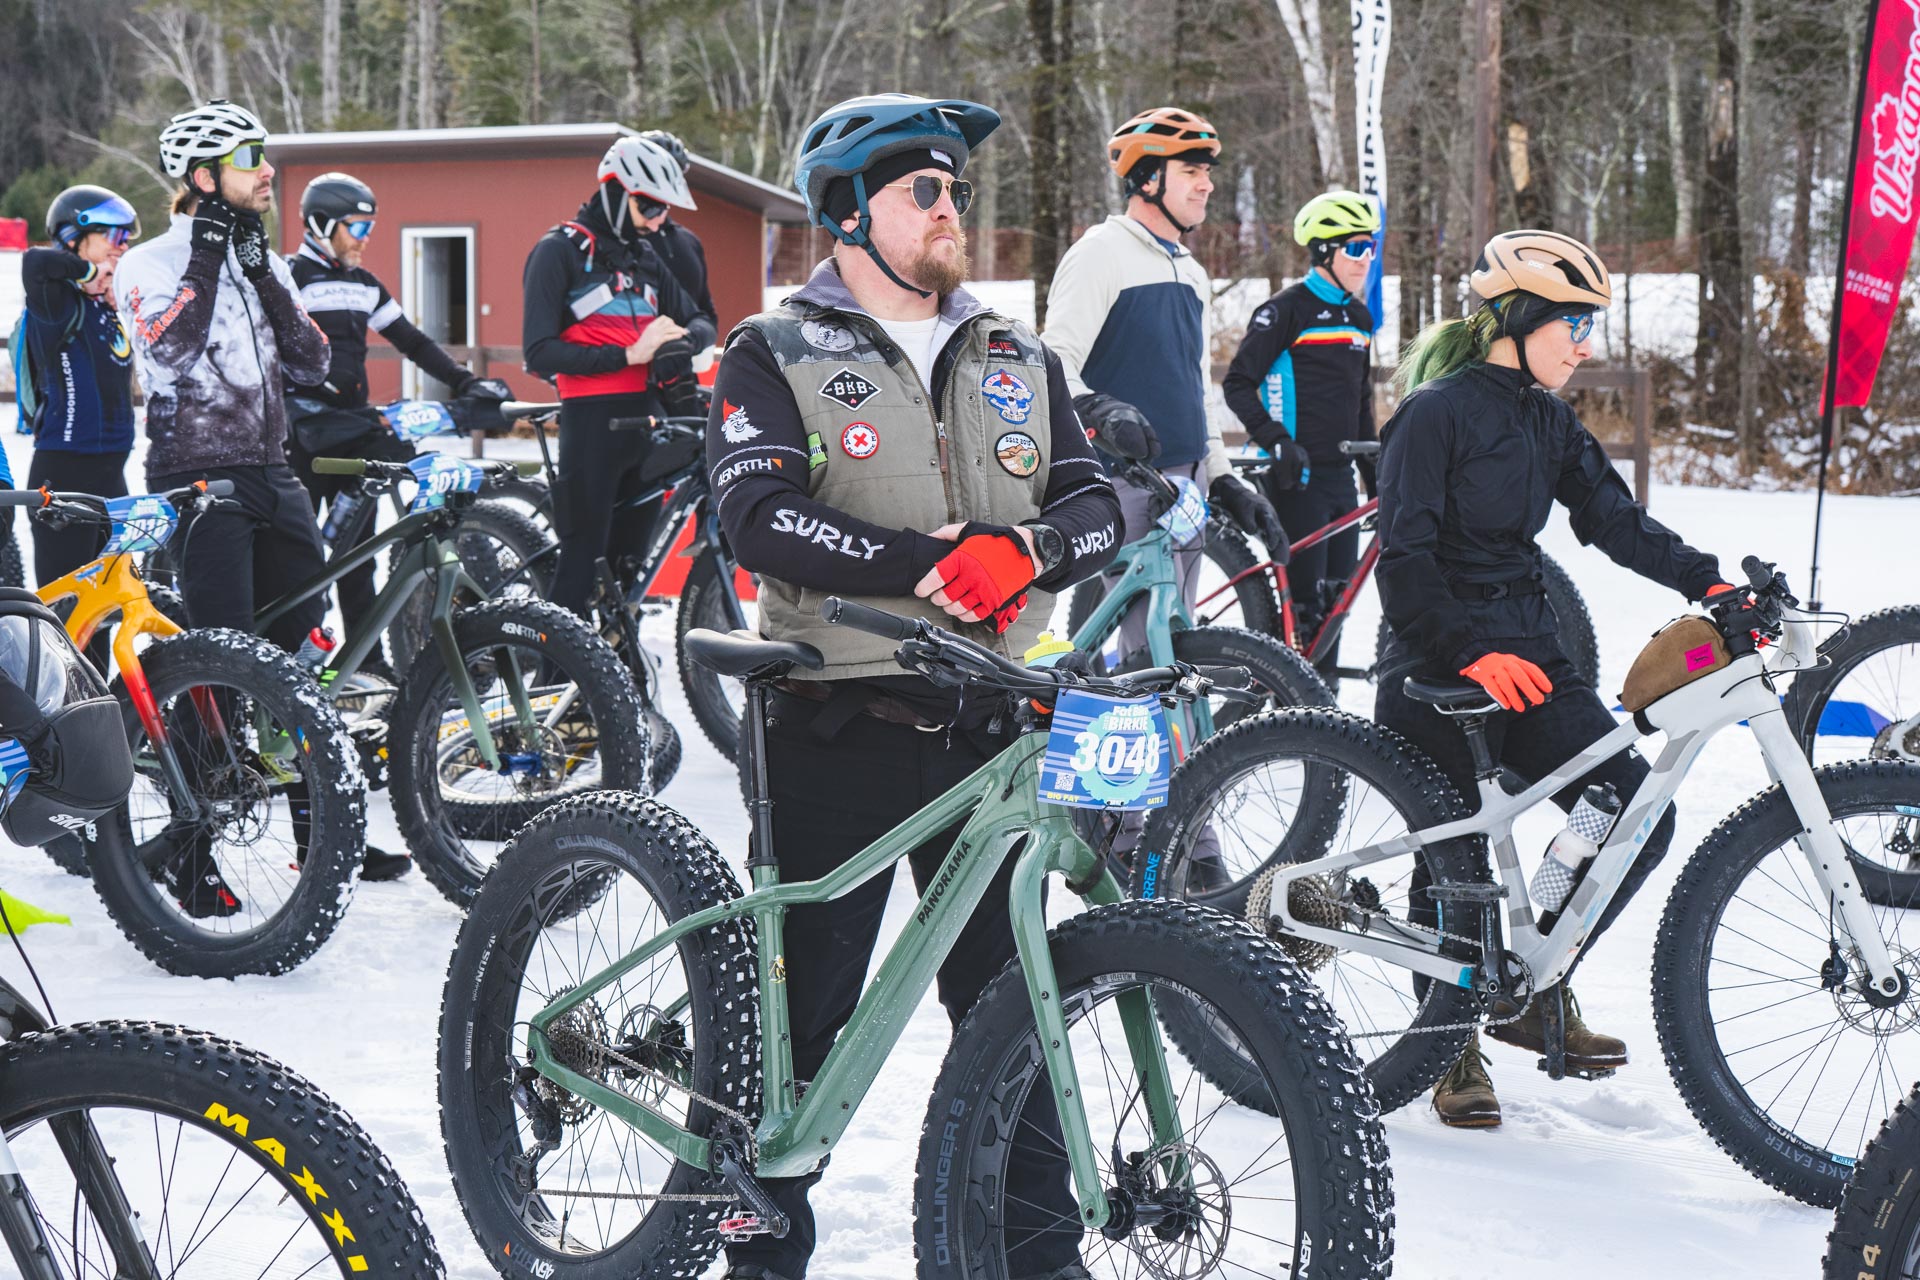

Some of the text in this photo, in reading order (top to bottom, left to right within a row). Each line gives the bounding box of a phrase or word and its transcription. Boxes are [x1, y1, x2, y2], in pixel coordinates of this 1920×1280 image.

[1847, 269, 1894, 293] NATURAL
[60, 352, 76, 442] NEWMOONSKI.COM
[834, 381, 868, 395] BKB
[426, 467, 472, 496] 3011
[717, 458, 778, 487] 45NRTH
[770, 508, 885, 560] SURLY
[1072, 521, 1114, 559] SURLY
[501, 622, 541, 642] 45NRTH
[1108, 717, 1149, 730] BIRKIE
[1070, 732, 1160, 775] 3048
[1046, 791, 1080, 803] BIG FAT
[555, 834, 628, 861] DILLINGER
[917, 840, 972, 926] PANORAMA
[1765, 1131, 1813, 1168] EATER
[204, 1102, 369, 1272] MAXXI
[934, 1098, 966, 1266] DILLINGER 5
[1863, 1244, 1881, 1267] 4
